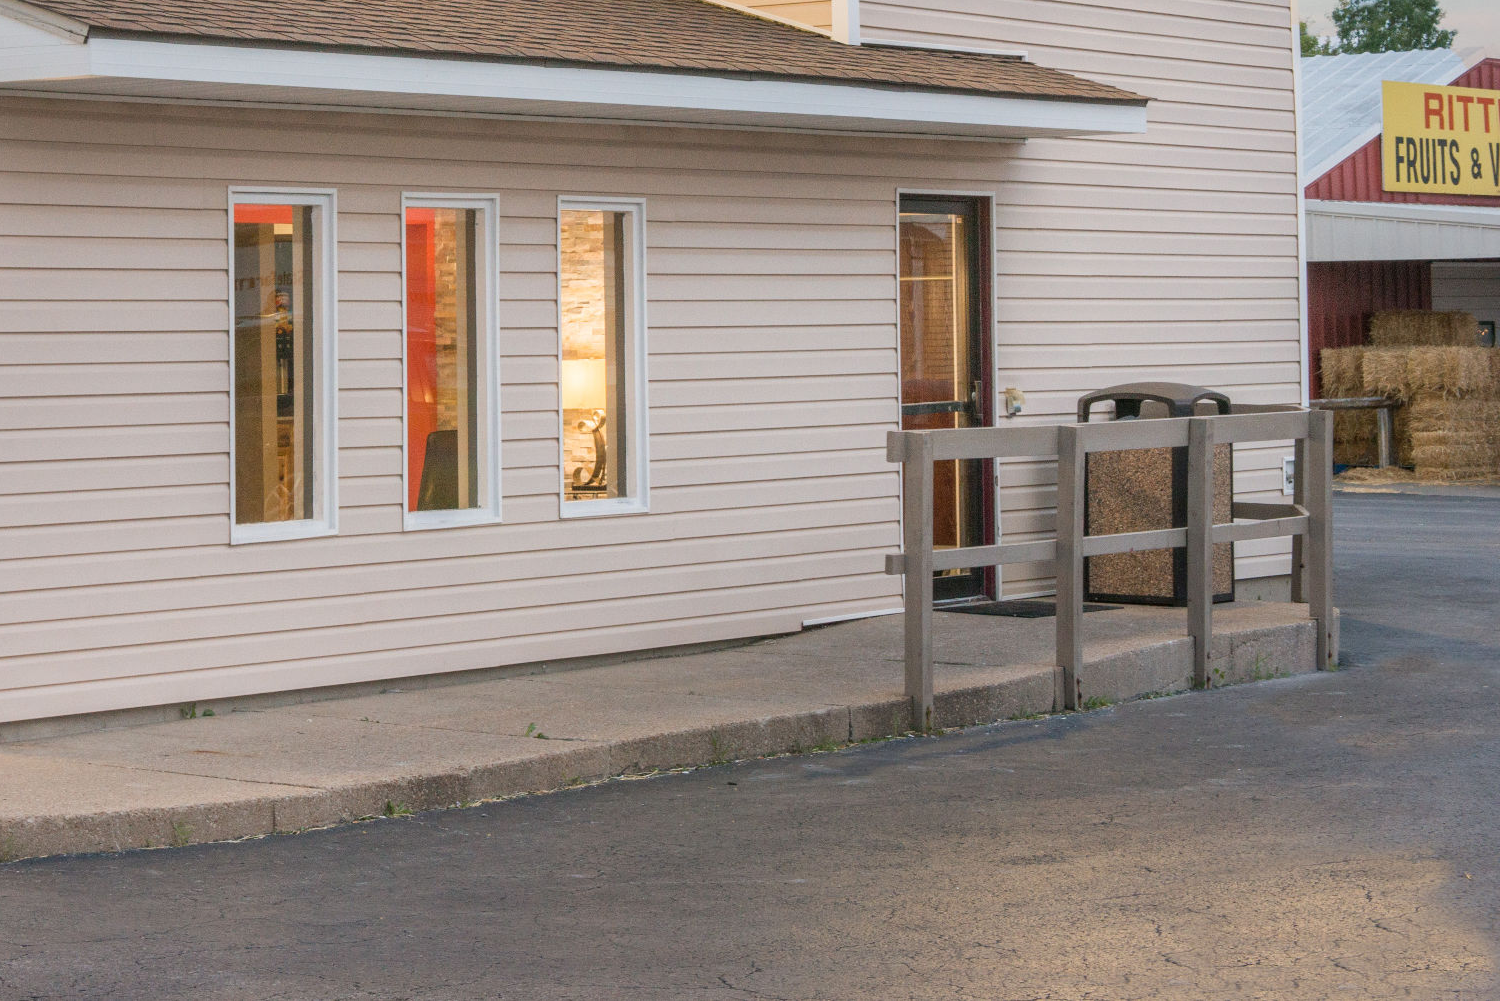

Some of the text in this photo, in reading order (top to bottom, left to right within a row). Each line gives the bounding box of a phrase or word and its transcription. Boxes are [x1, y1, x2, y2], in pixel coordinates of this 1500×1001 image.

[1423, 92, 1500, 134] RITT
[1395, 136, 1461, 186] FRUITS
[1470, 147, 1483, 180] &
